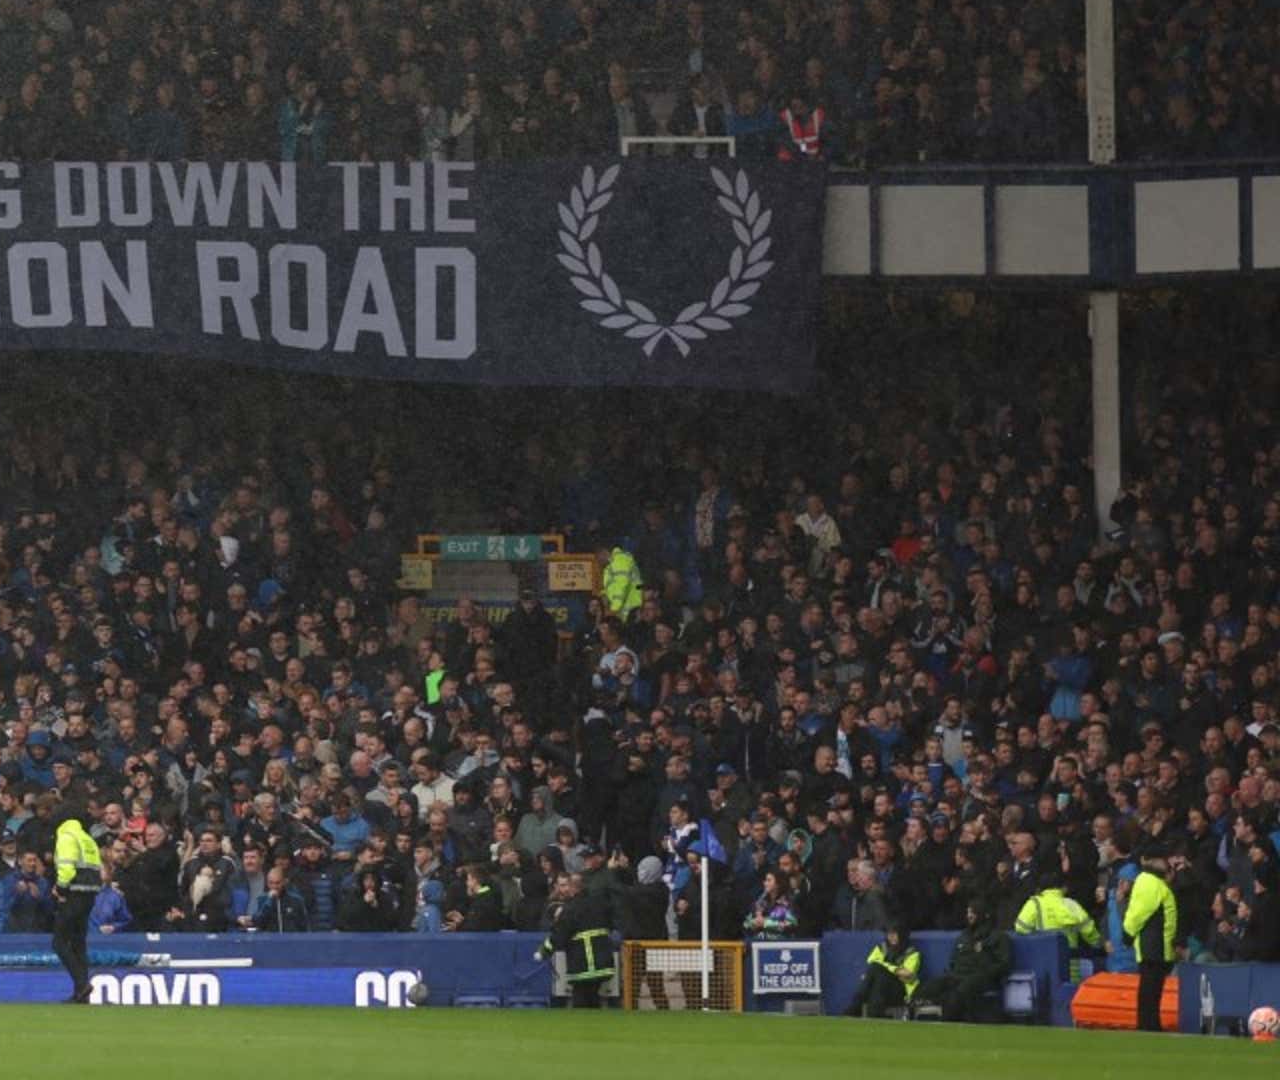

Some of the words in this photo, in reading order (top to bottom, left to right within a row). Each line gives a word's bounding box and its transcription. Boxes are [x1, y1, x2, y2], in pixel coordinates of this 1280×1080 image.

[54, 161, 297, 229] DOWN
[328, 161, 477, 233] THE
[195, 240, 477, 360] ROAD
[447, 541, 480, 553] EXIT
[763, 963, 788, 974] KEEP
[790, 963, 809, 974] OFF
[760, 975, 779, 987] THE
[781, 975, 813, 987] GRASS
